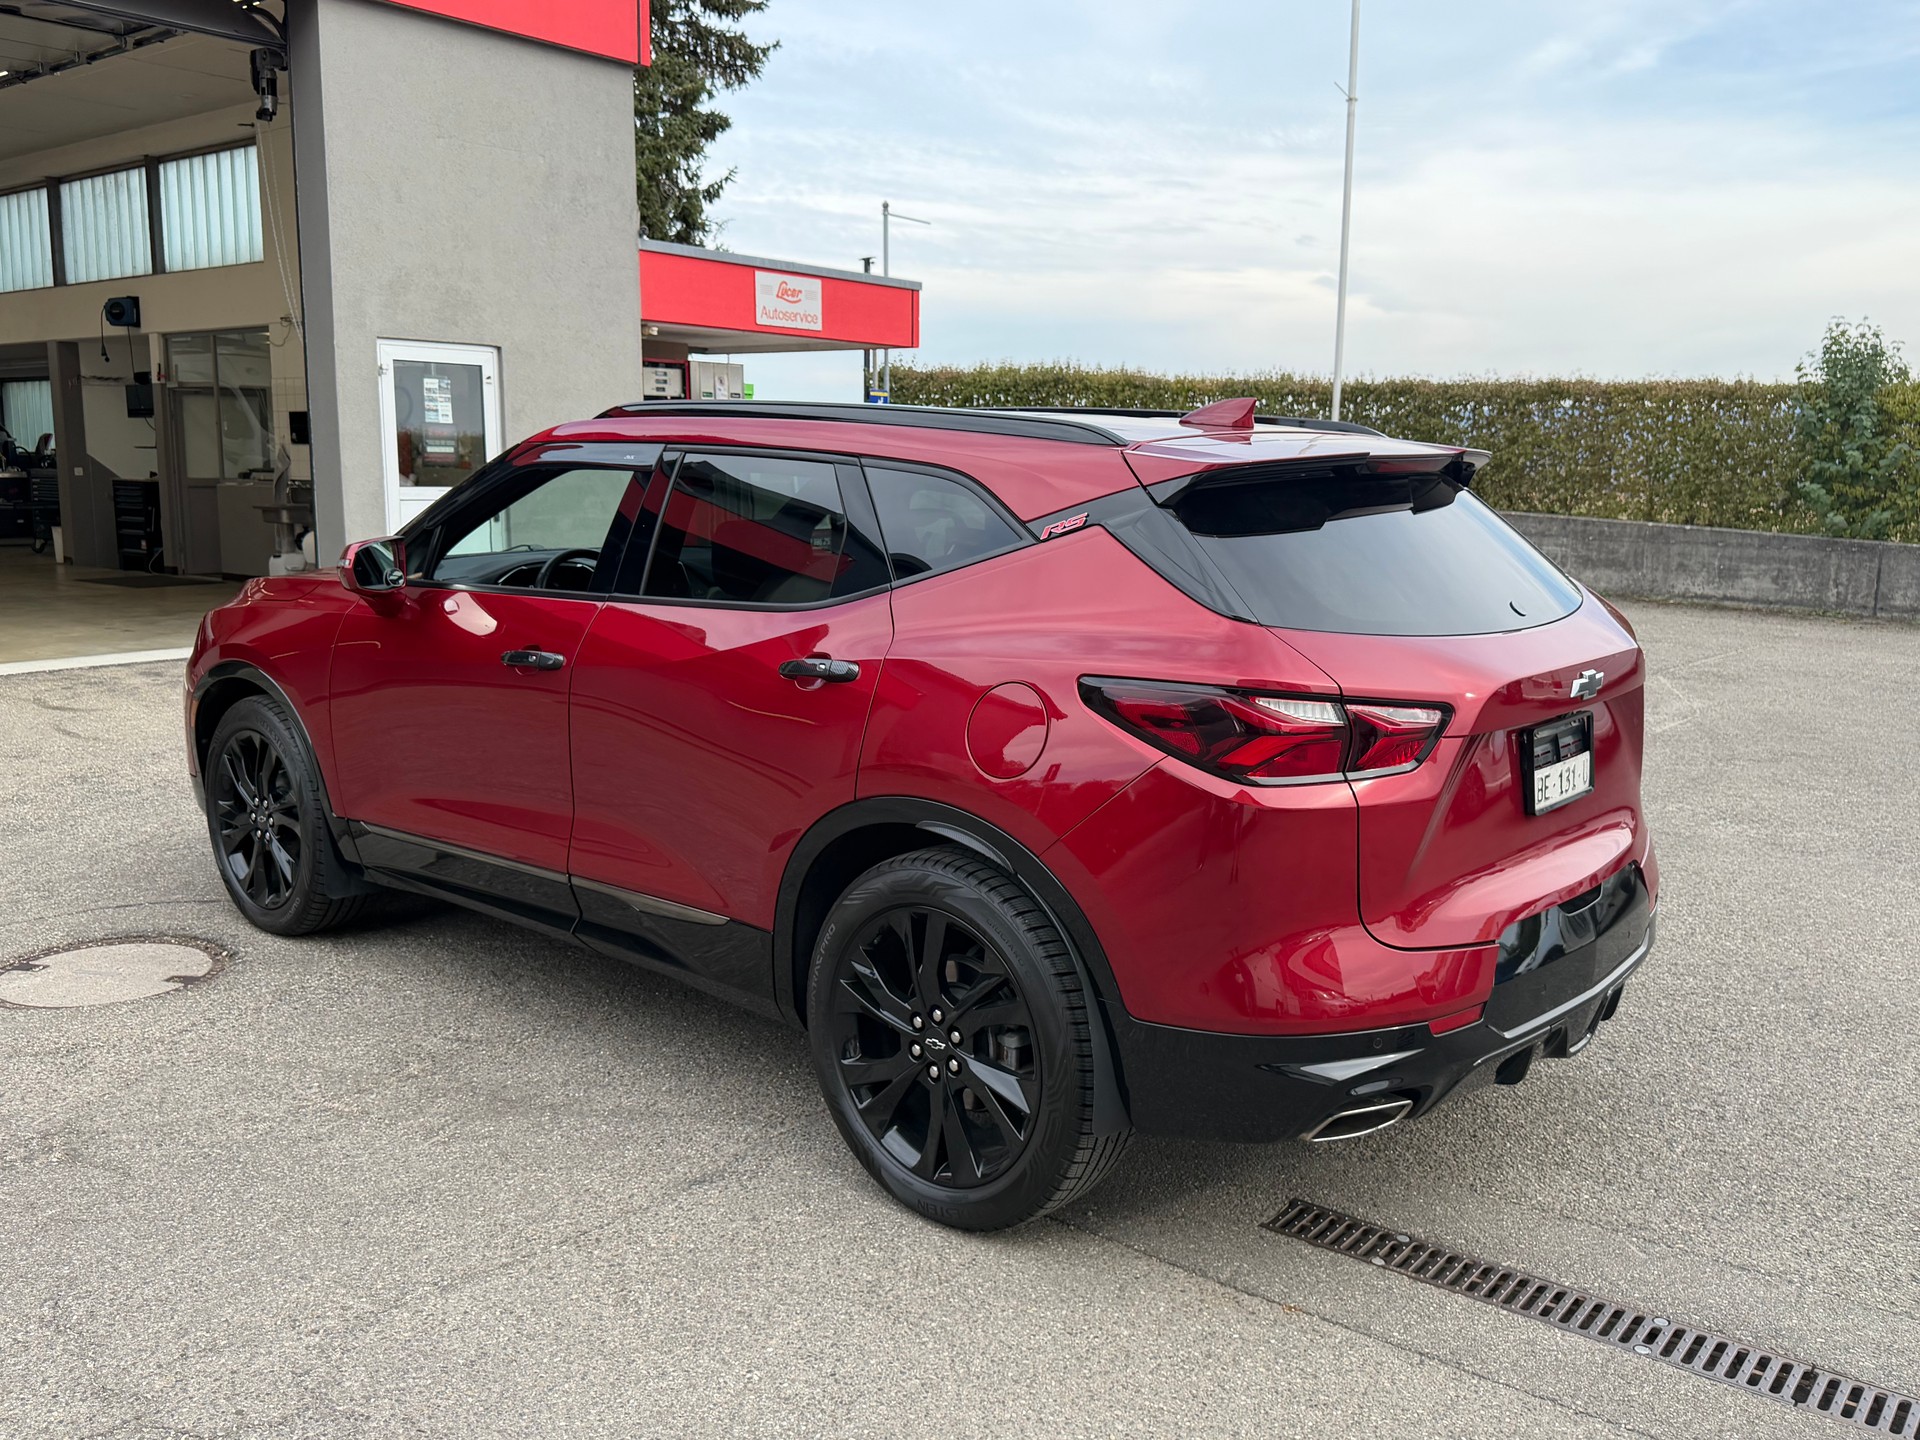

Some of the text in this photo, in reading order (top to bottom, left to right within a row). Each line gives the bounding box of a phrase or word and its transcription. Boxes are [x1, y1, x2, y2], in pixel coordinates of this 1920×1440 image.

[761, 305, 819, 325] Autoservice
[1040, 512, 1089, 541] RS
[1536, 773, 1551, 804] BE
[1559, 762, 1577, 797] 131
